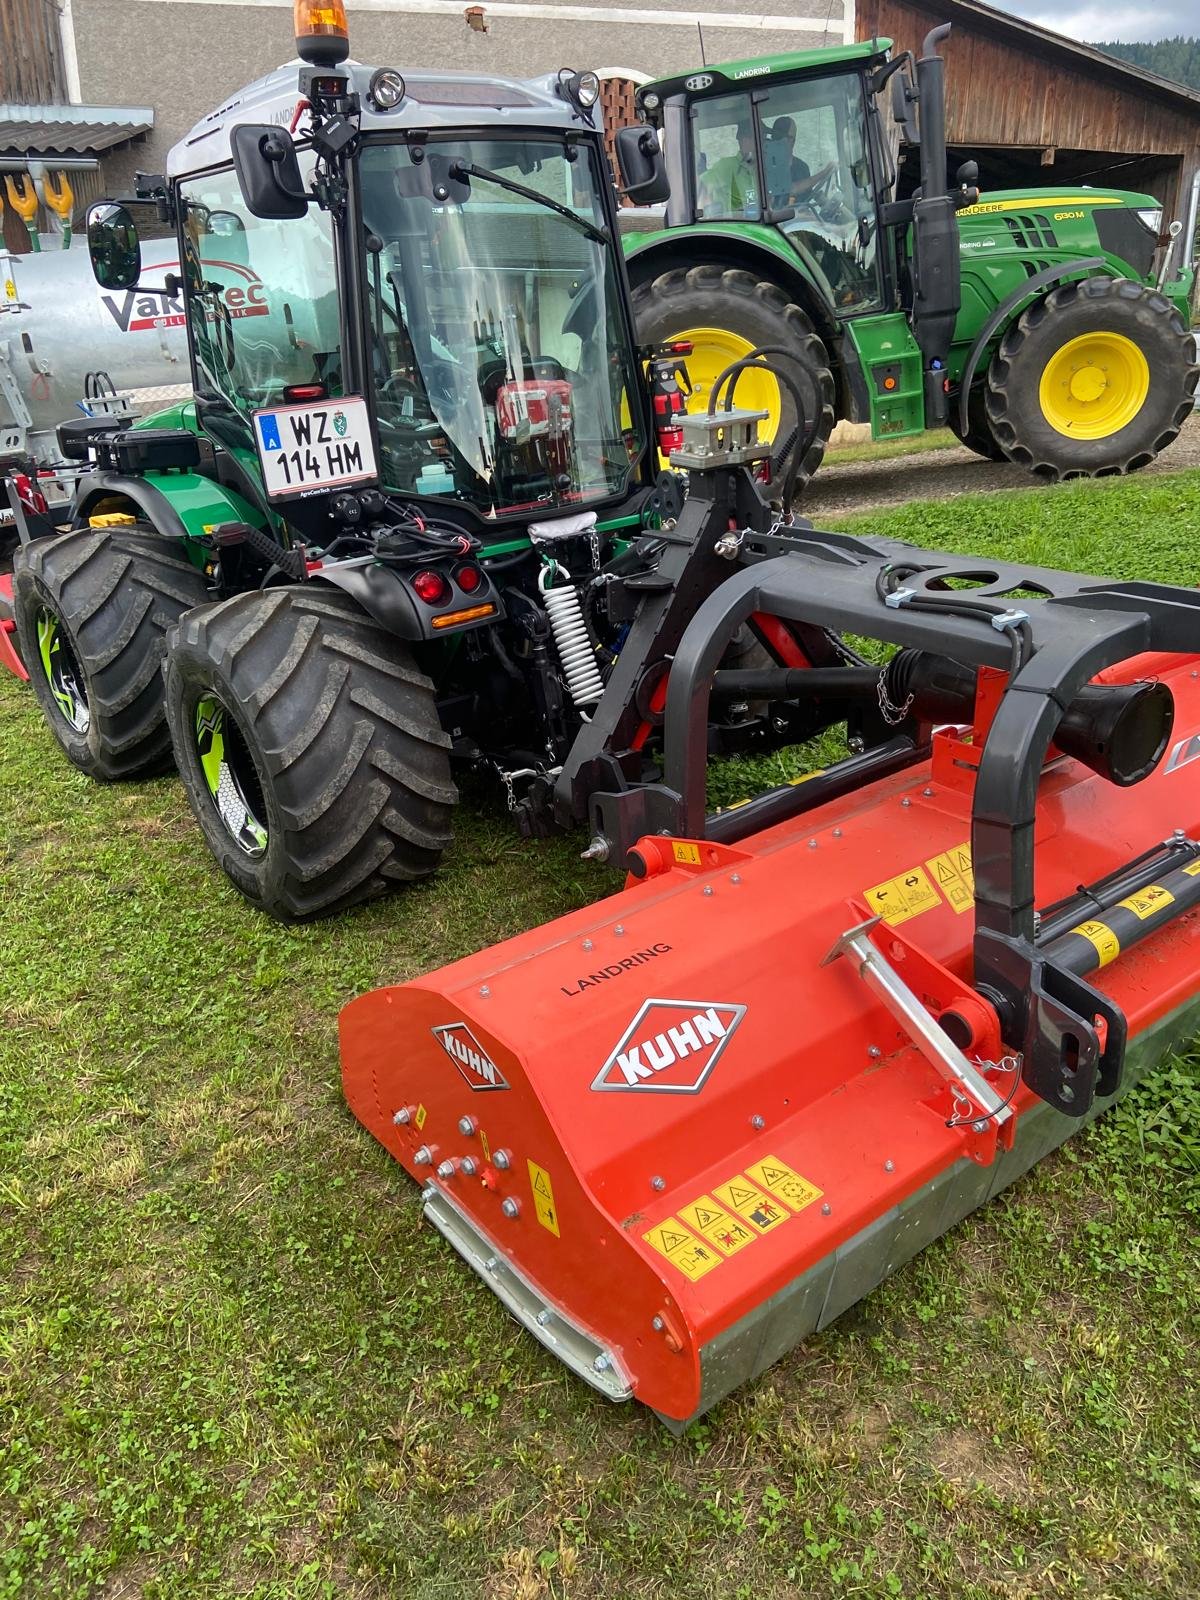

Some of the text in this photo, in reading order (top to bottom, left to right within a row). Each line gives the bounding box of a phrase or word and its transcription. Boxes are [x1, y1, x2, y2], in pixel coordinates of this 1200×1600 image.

[734, 66, 770, 79] LANDRING
[973, 204, 1003, 214] DEERE
[269, 438, 277, 448] A
[290, 412, 332, 446] WZ
[277, 441, 362, 484] 114 HM
[560, 943, 672, 996] LANDRING
[443, 1030, 497, 1086] KUHN
[616, 1007, 727, 1086] KUHN
[796, 1191, 814, 1206] STOP
